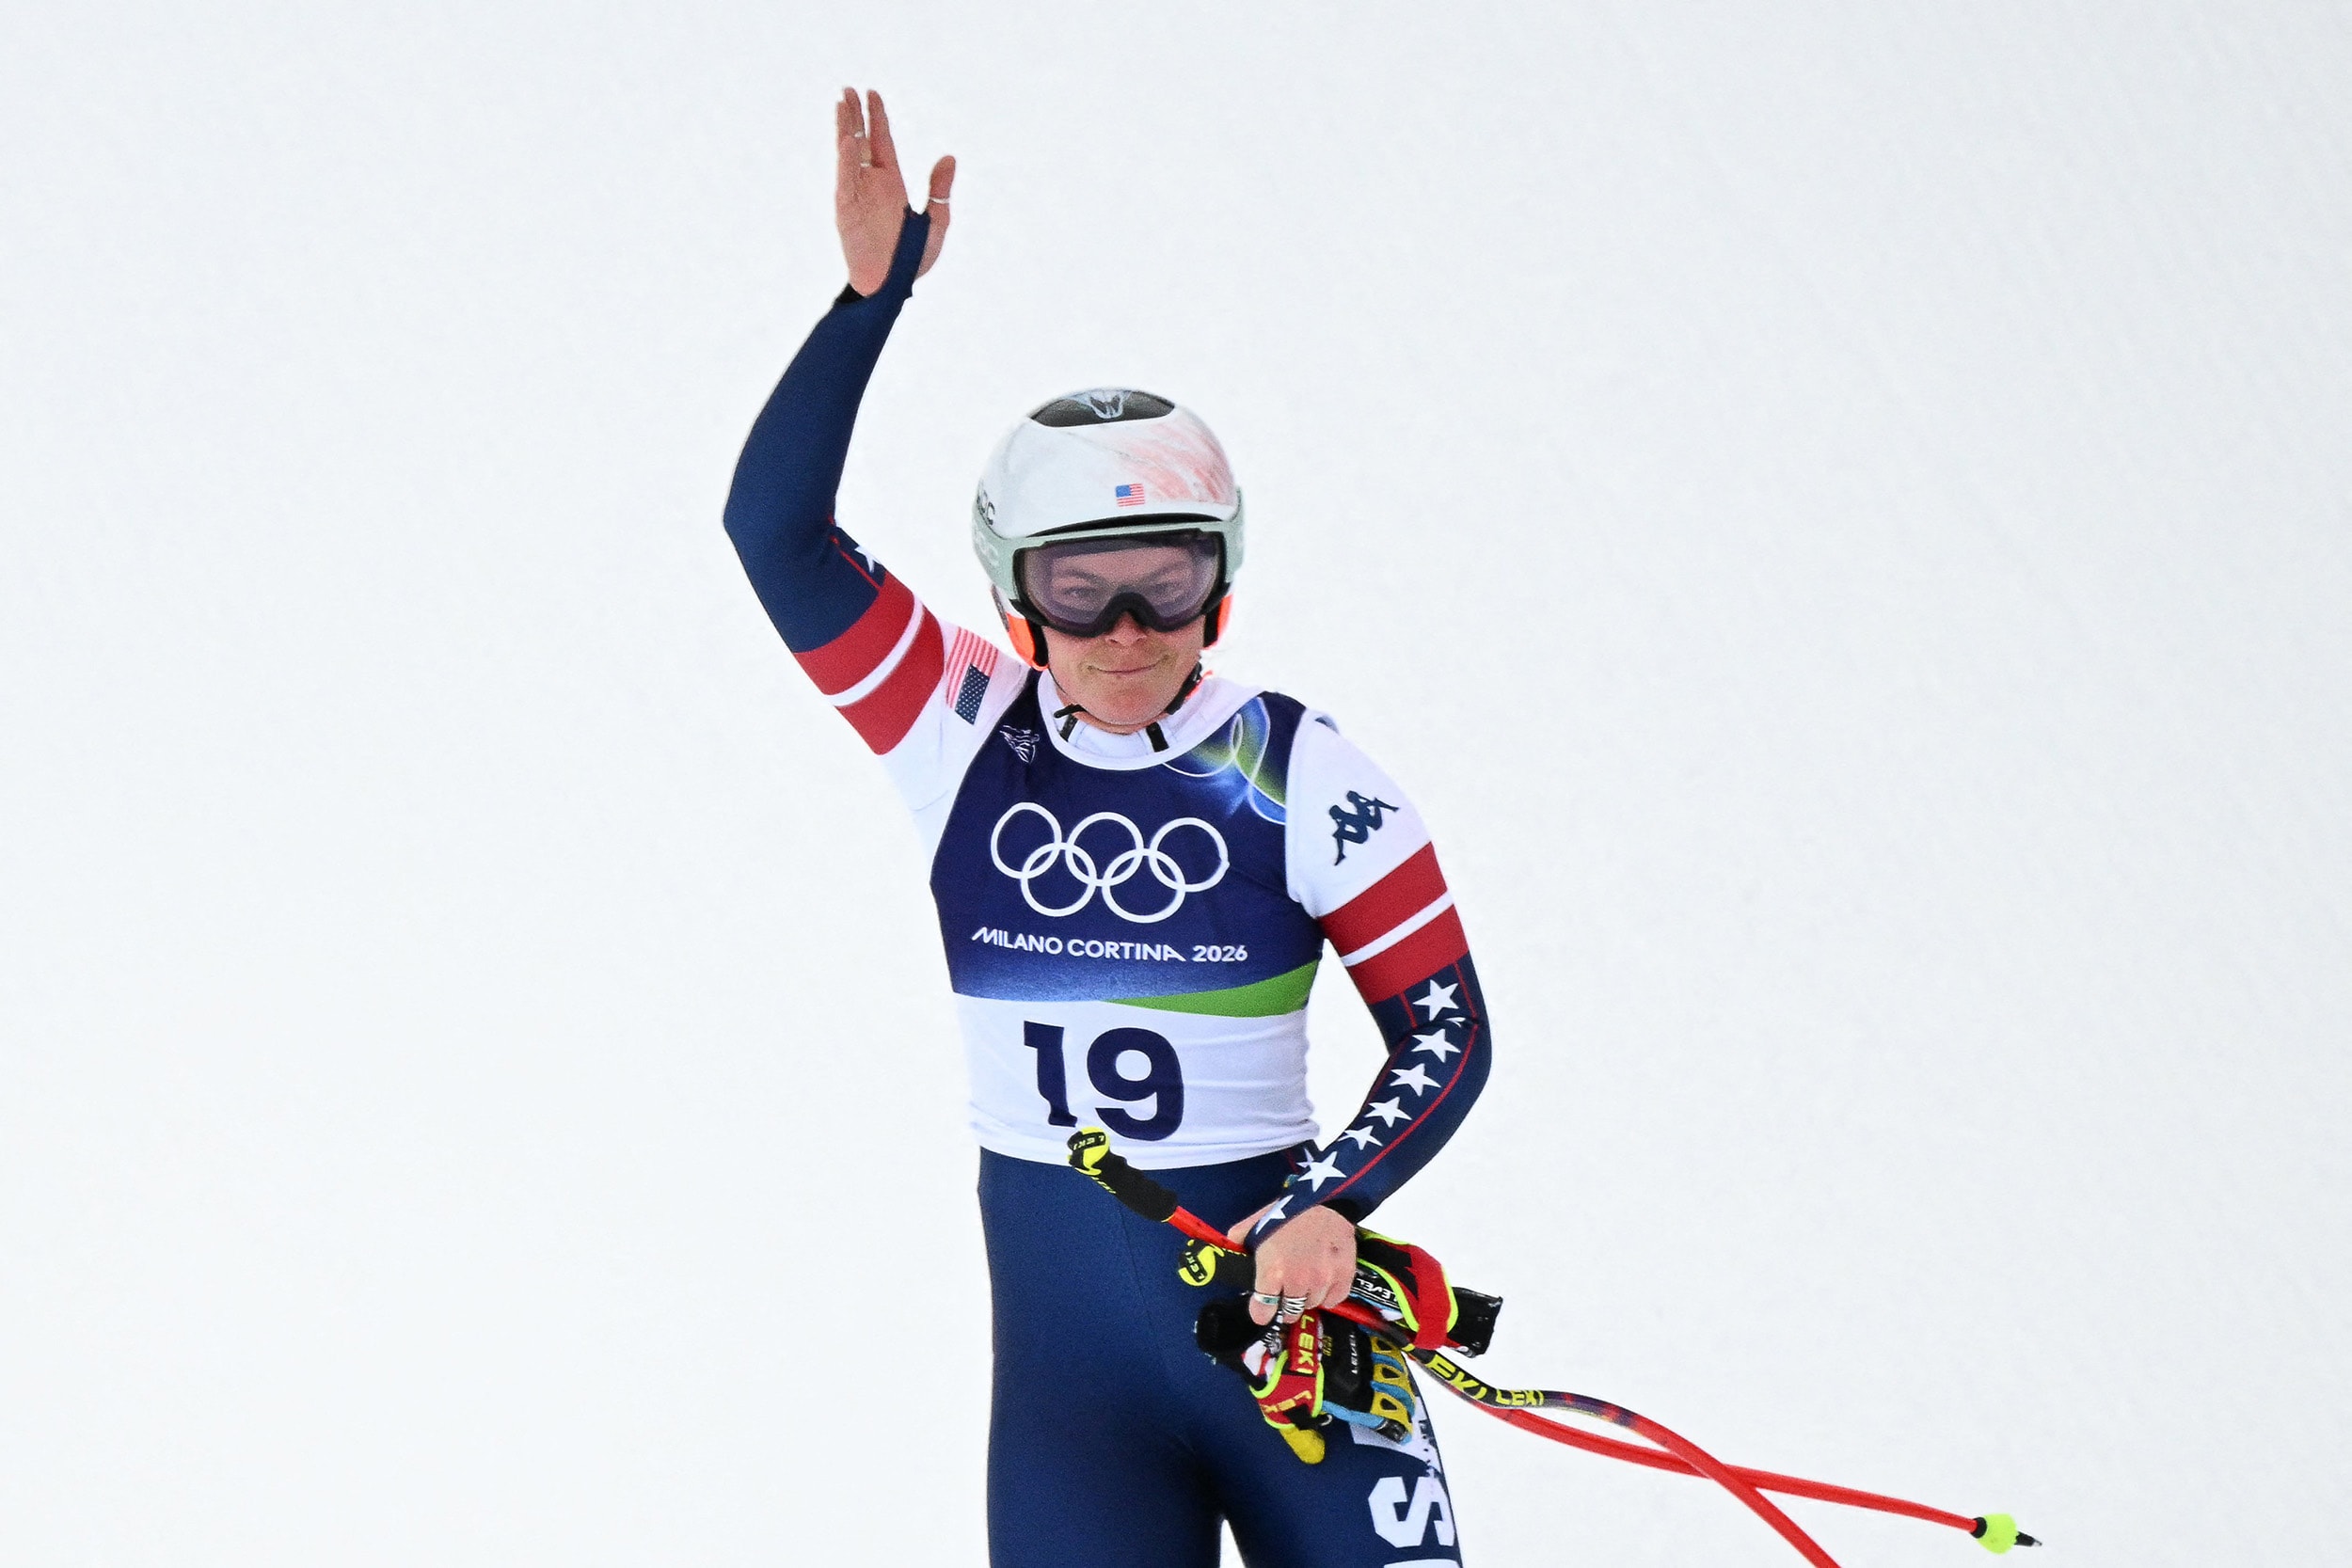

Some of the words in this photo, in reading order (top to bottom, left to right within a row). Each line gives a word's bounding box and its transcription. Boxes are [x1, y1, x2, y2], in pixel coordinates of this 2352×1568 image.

[972, 927, 1064, 956] MILANO
[1067, 938, 1187, 962] CORTINA
[1191, 944, 1248, 963] 2026
[1024, 1020, 1185, 1142] 19
[1073, 1135, 1104, 1150] LEKI
[1184, 1251, 1205, 1280] LEKI
[1296, 1315, 1315, 1375] LEKI
[1425, 1354, 1488, 1400] EKI
[1495, 1388, 1545, 1406] LEKI
[1260, 1390, 1313, 1414] LEK
